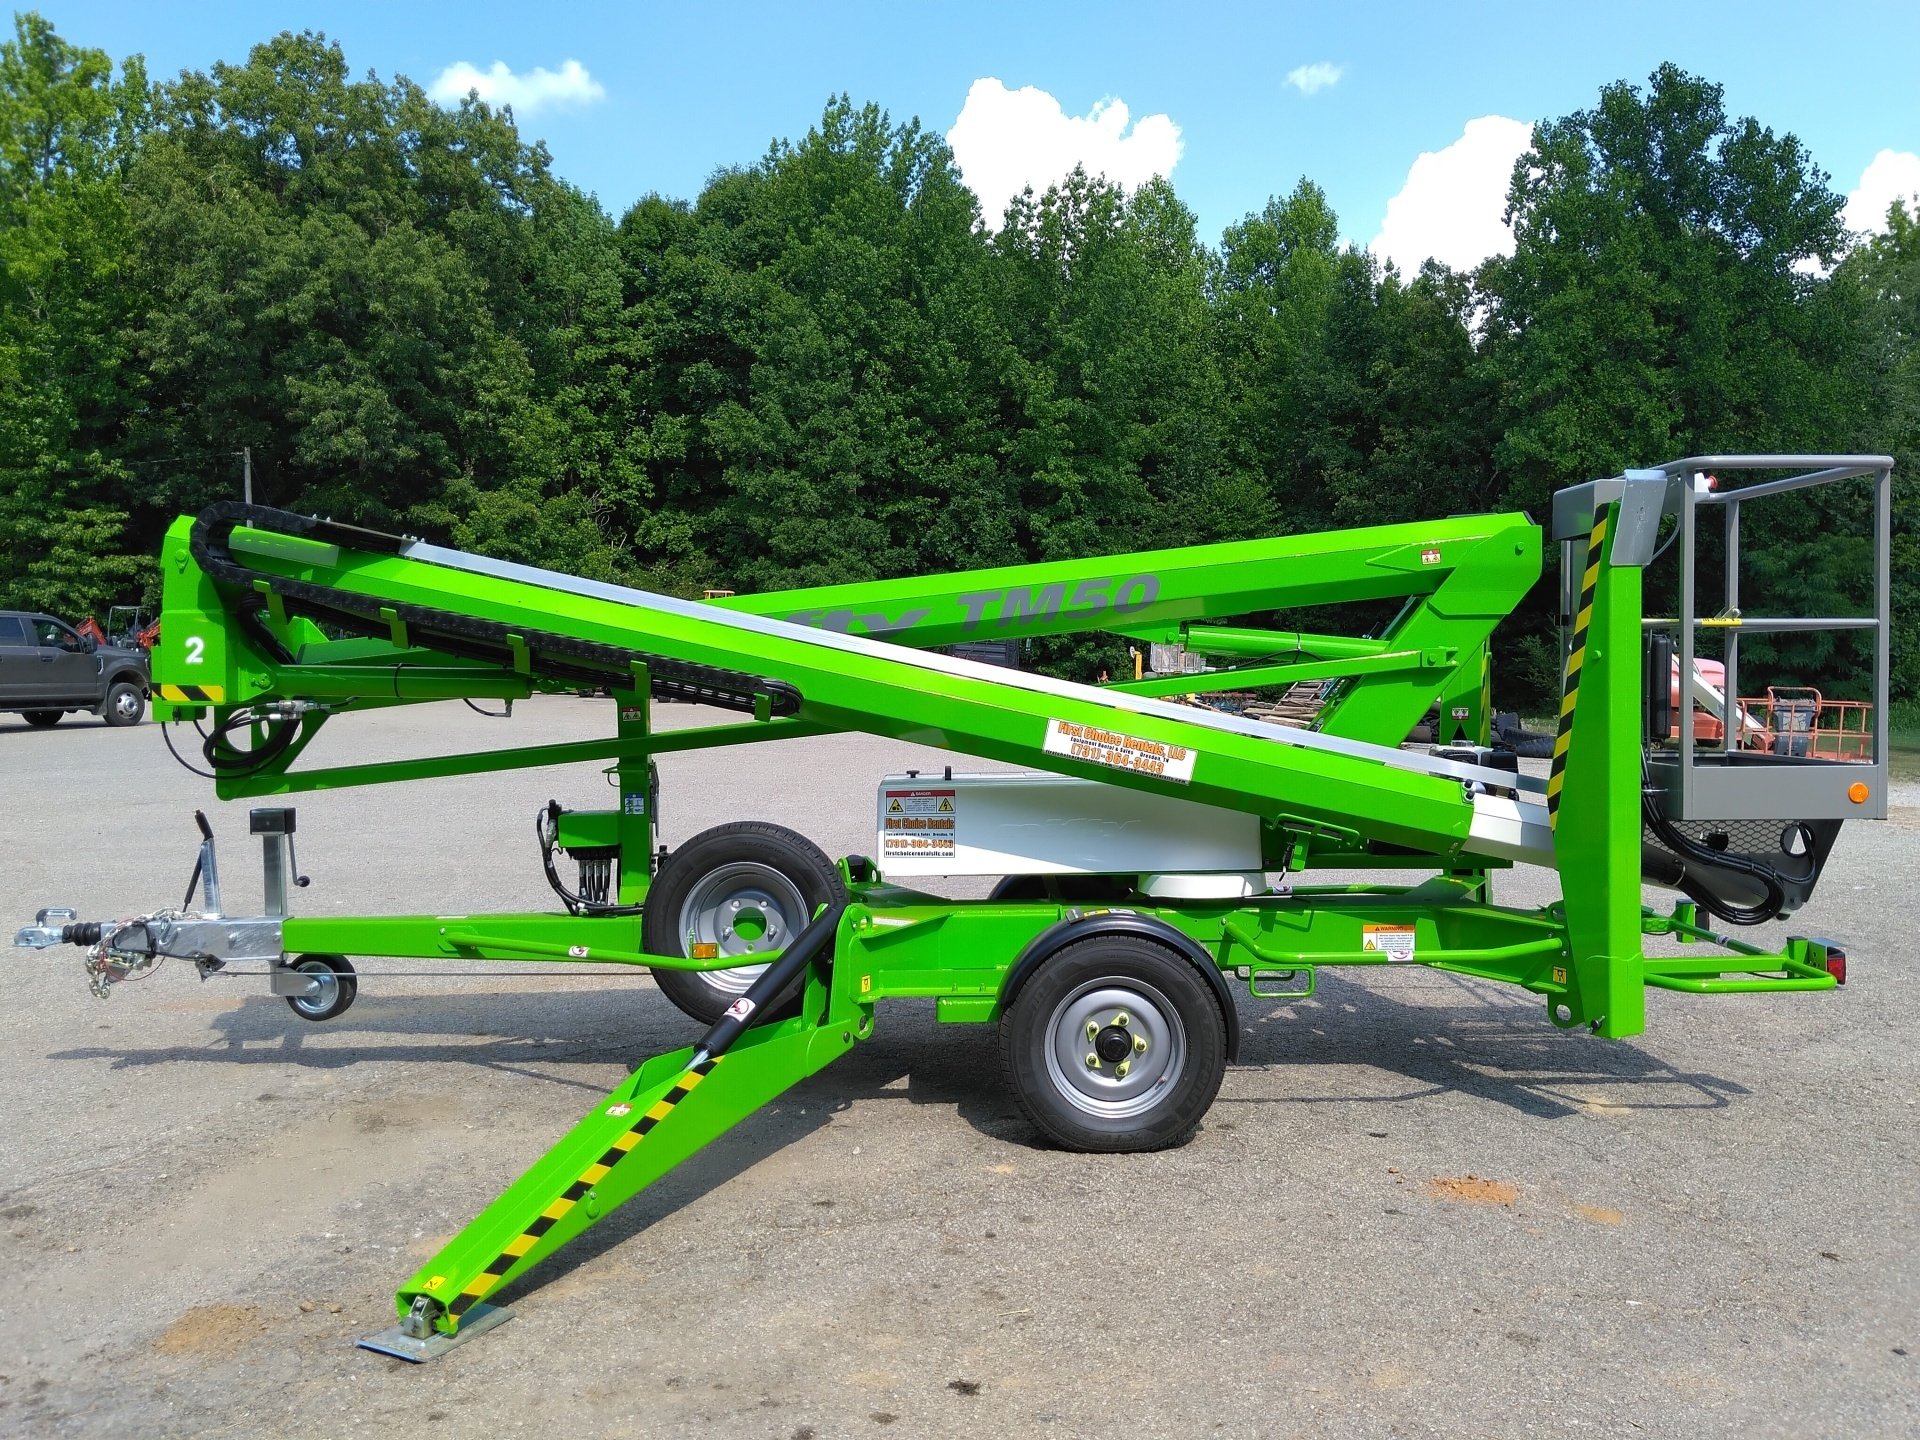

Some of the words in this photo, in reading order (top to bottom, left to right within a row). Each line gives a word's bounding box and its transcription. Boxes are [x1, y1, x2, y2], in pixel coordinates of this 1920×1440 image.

[955, 574, 1161, 632] TM50
[185, 636, 204, 664] 2
[1057, 721, 1084, 737] First
[1084, 727, 1122, 746] Choice
[1167, 745, 1187, 761] LLC
[1070, 742, 1165, 775] (731)-364-3443
[885, 817, 901, 830] First
[902, 817, 927, 830] Choice
[927, 817, 954, 830] Rentals
